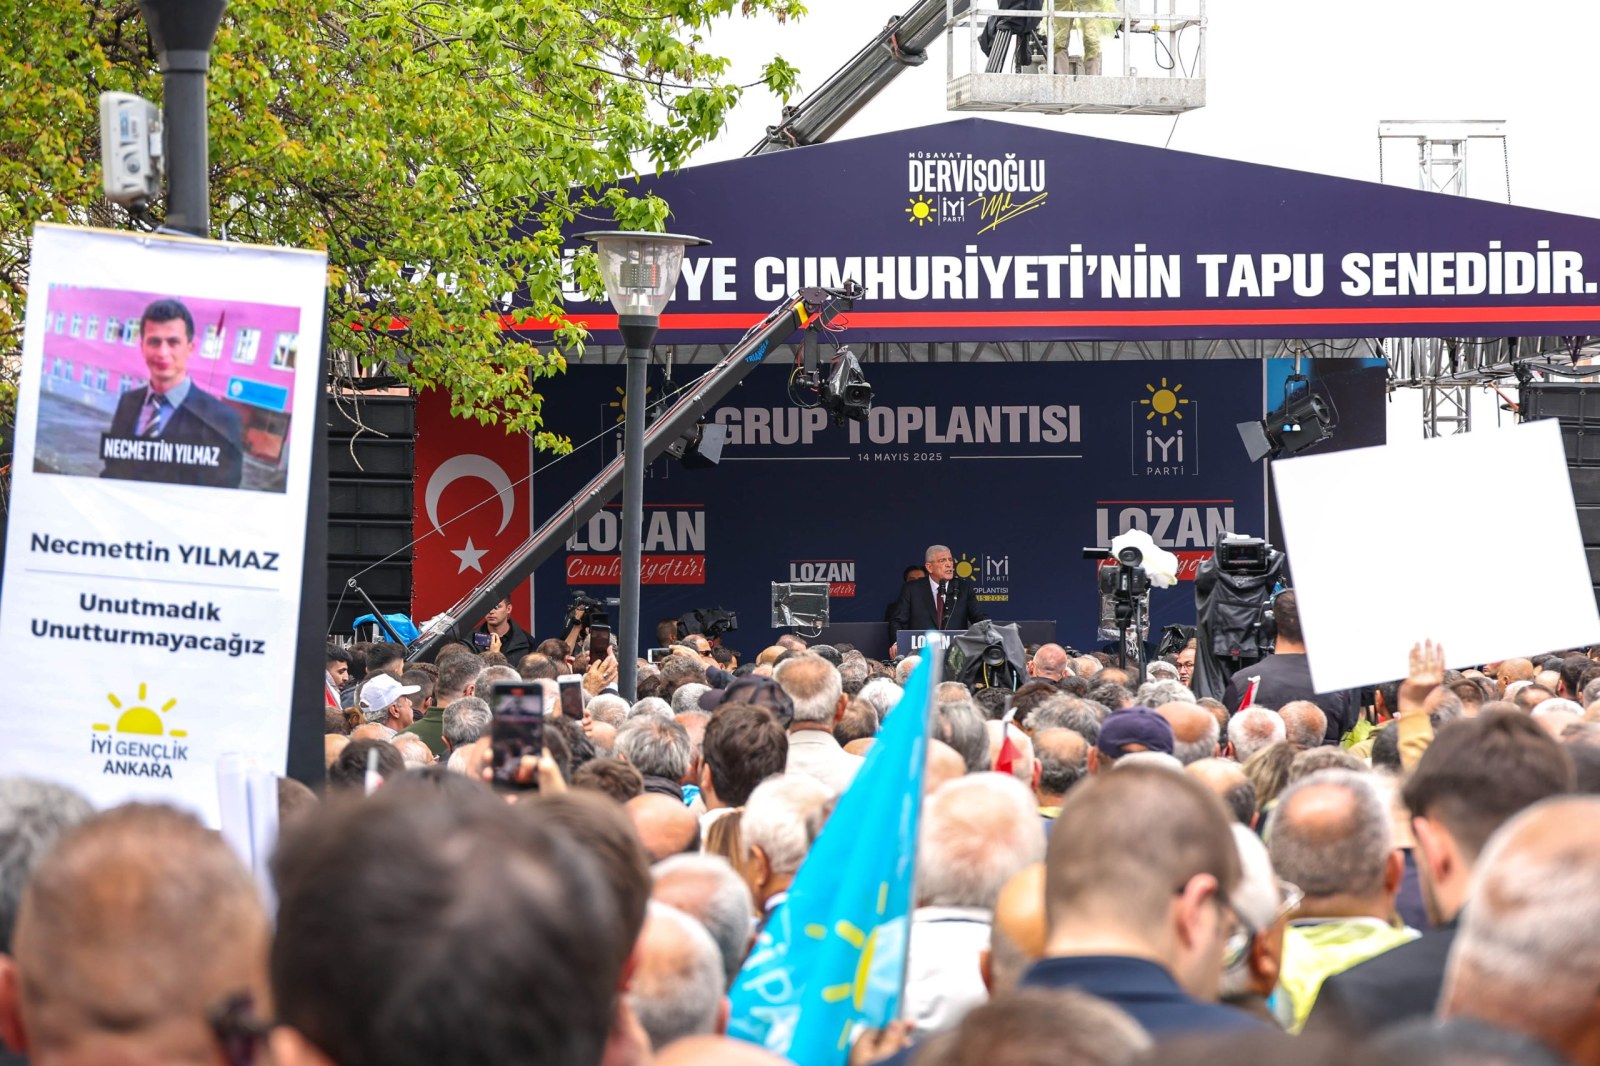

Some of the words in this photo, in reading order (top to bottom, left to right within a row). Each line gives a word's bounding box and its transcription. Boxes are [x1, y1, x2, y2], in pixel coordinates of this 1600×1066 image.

[909, 151, 962, 159] MÜSAVAT
[909, 153, 1046, 197] DERVİŞOĞLU
[943, 197, 965, 216] İYİ
[754, 243, 1181, 301] CUMHURİYETİ’NİN
[1197, 253, 1324, 297] TAPU
[1340, 240, 1598, 296] SENEDİDİR.
[714, 406, 828, 445] GRUP
[104, 437, 174, 463] NECMETTİN
[175, 442, 221, 466] YILMAZ
[858, 453, 869, 461] 14
[874, 453, 909, 461] MAYIS
[913, 452, 942, 461] 2025
[1146, 429, 1183, 463] İYİ
[1147, 466, 1184, 475] PARTİ
[566, 511, 706, 551] LOAN
[31, 533, 170, 563] Necmettin
[178, 544, 280, 572] YILMAZ
[986, 555, 1009, 576] İYİ
[567, 558, 706, 583] Cumhiyettir!
[790, 562, 855, 582] LOZAN
[79, 593, 221, 622] Unutmadık
[31, 619, 266, 657] Unutturmayacağız
[911, 635, 951, 650] LON
[91, 734, 113, 755] İYİ
[116, 740, 189, 762] GENÇLİK
[103, 759, 173, 780] ANKARA
